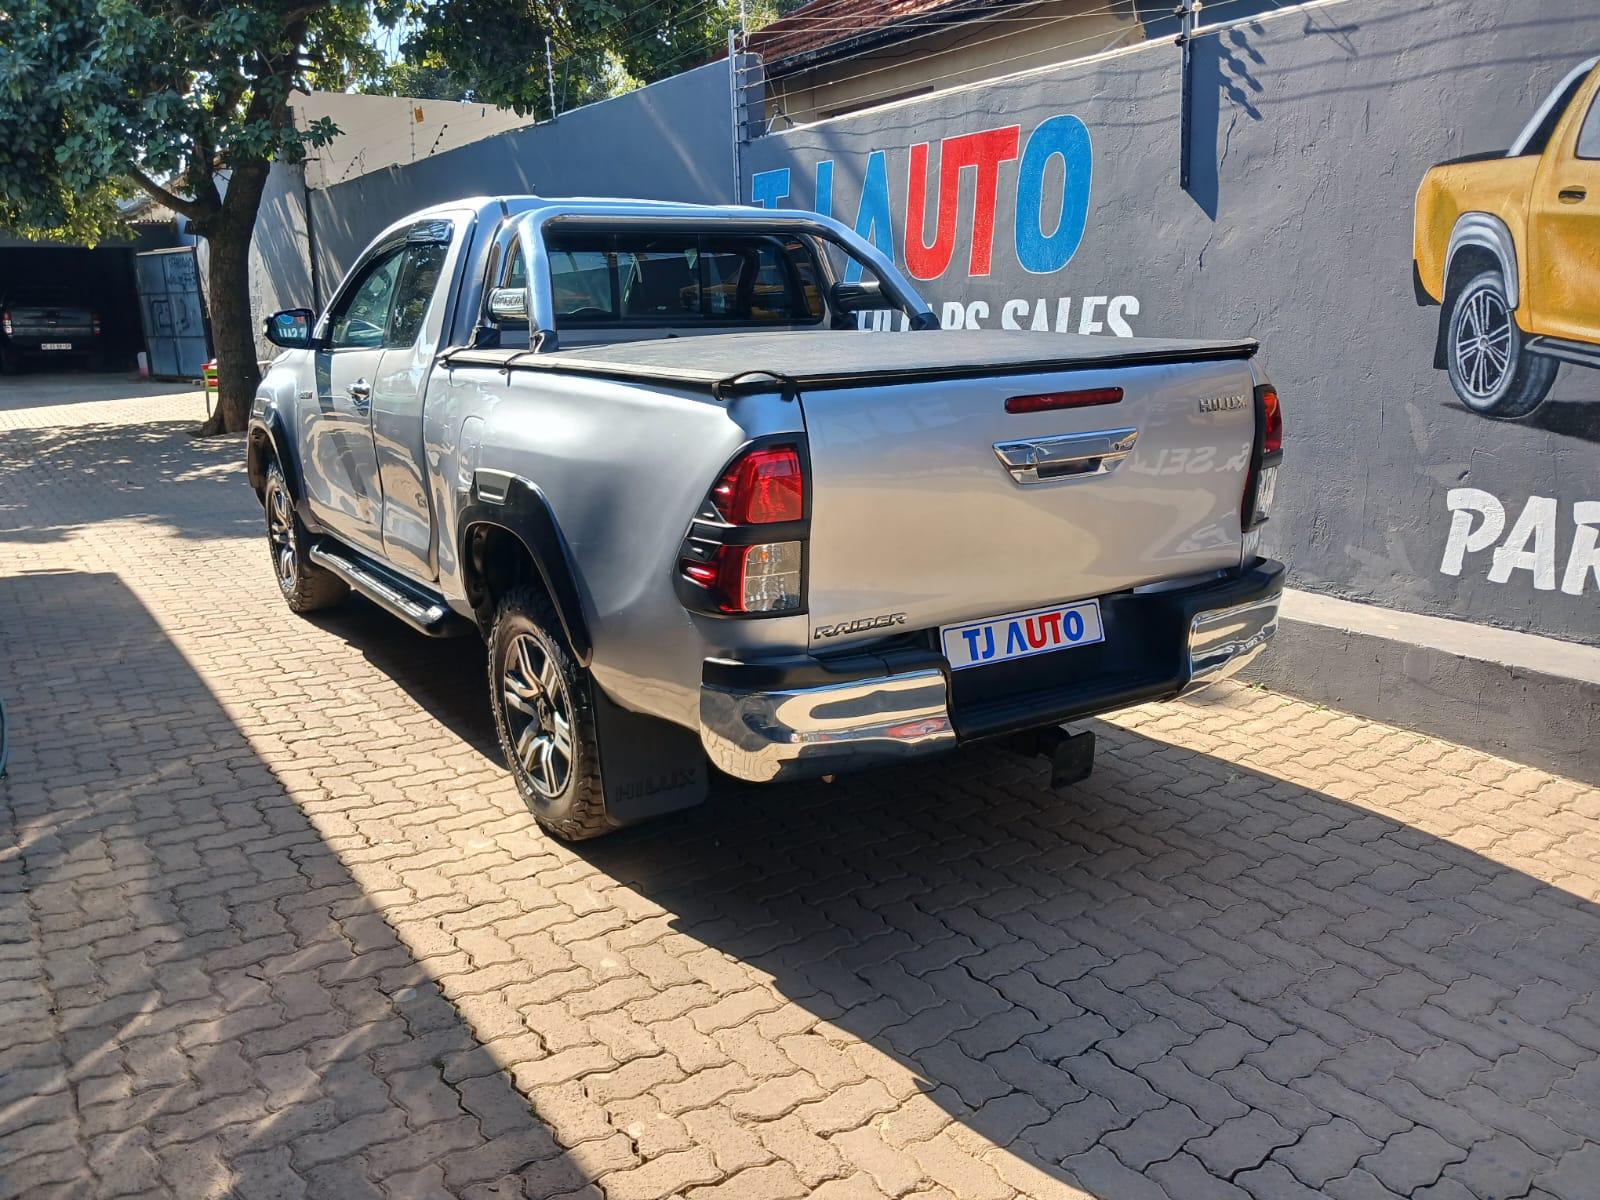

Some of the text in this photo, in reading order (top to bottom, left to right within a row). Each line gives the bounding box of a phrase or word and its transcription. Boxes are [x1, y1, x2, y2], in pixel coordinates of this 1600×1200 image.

[843, 113, 1093, 283] AUTO
[1199, 394, 1248, 413] HILUX
[813, 611, 908, 640] RAIDER
[962, 610, 1085, 662] TJ AUTO
[614, 767, 697, 803] HILUX
